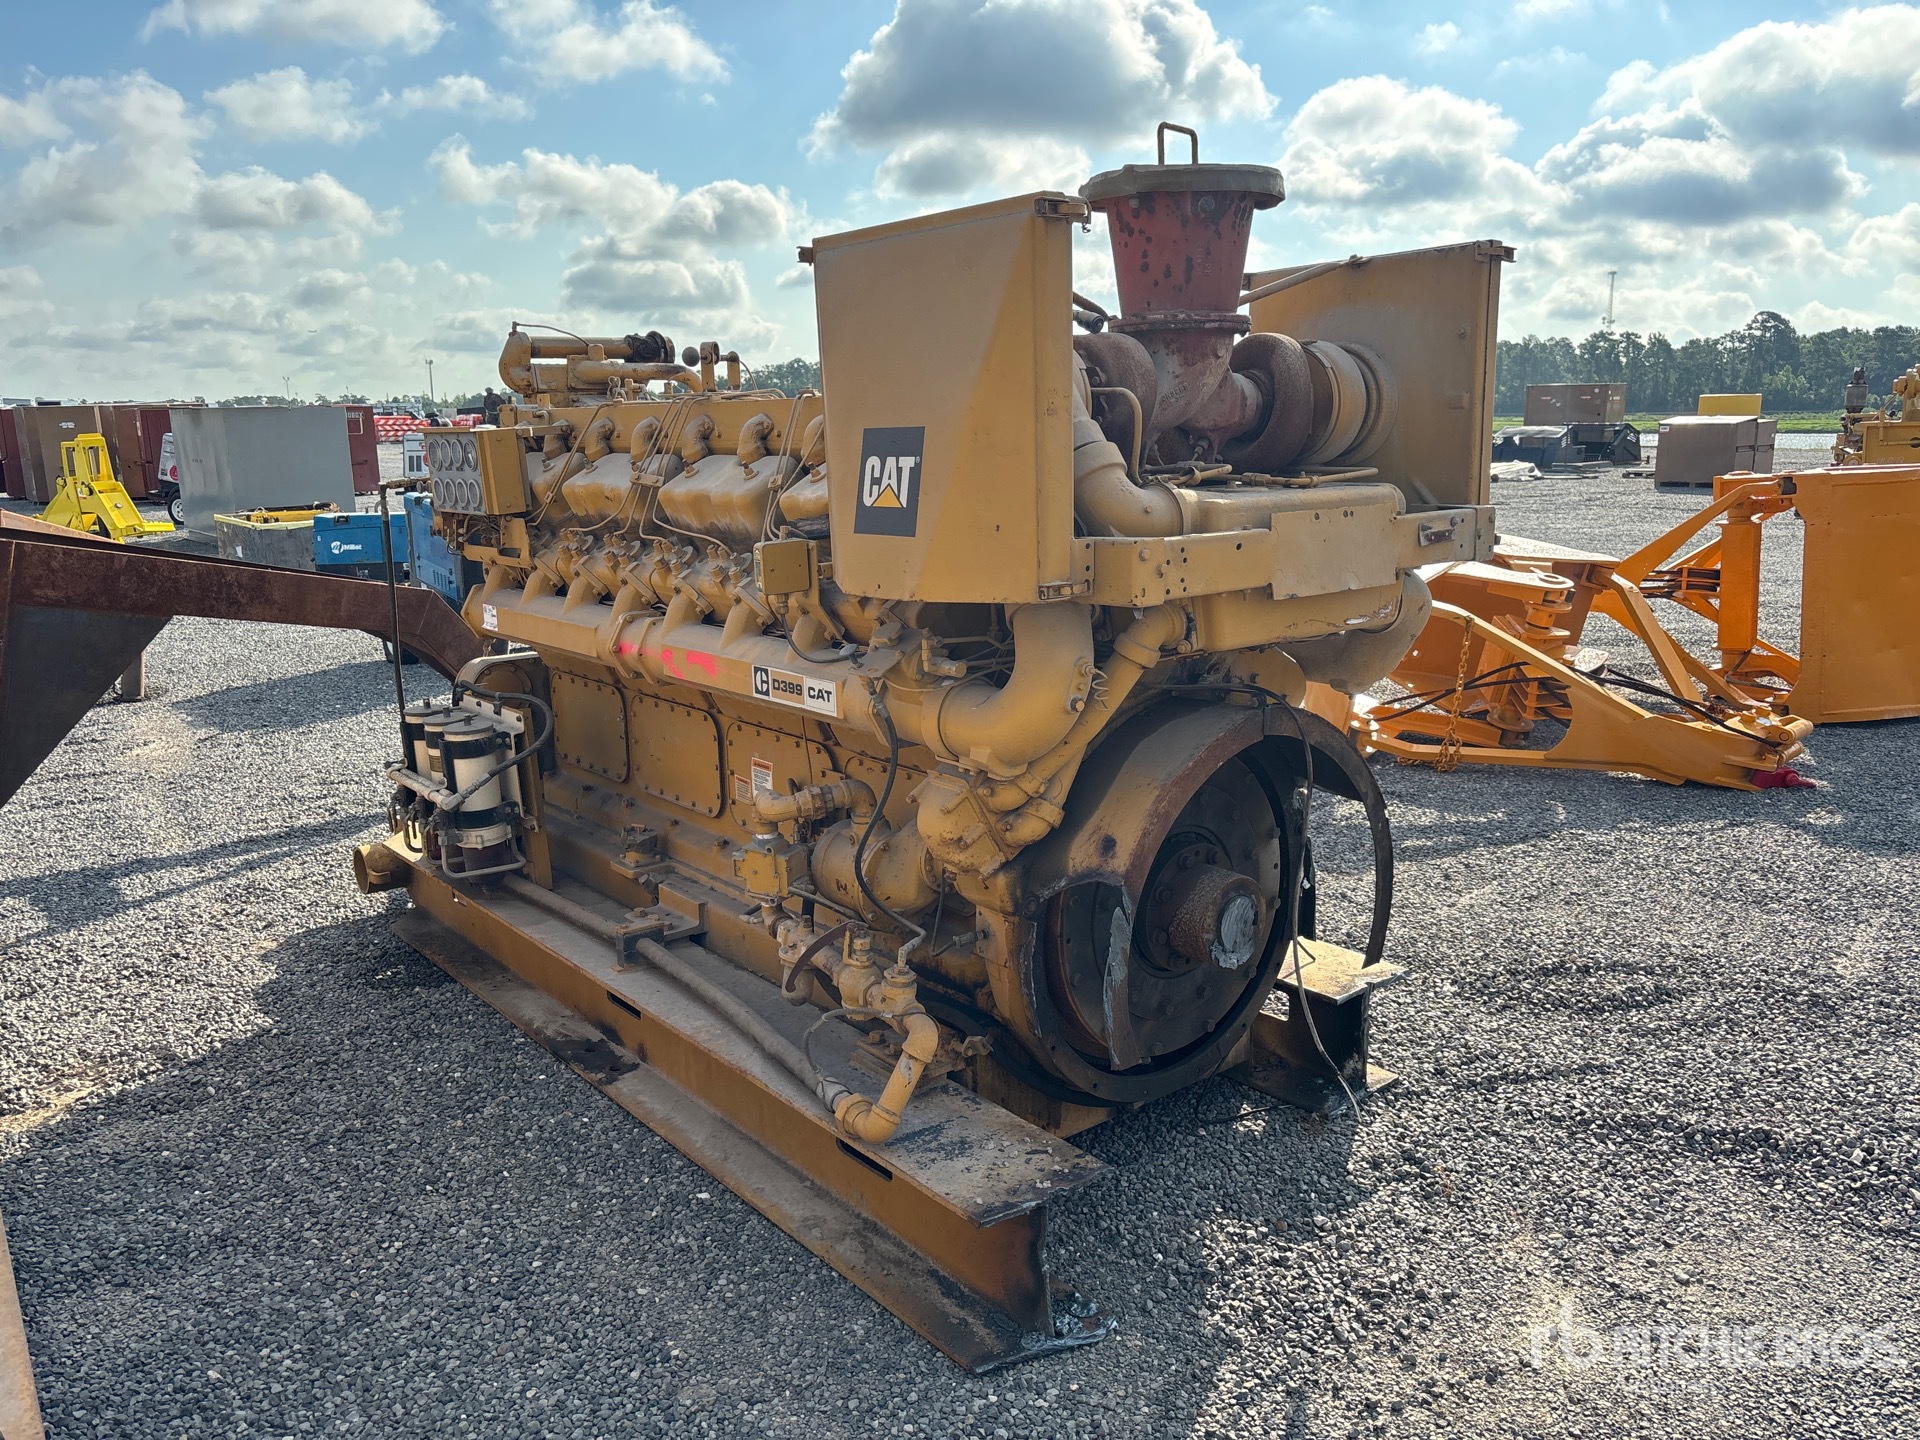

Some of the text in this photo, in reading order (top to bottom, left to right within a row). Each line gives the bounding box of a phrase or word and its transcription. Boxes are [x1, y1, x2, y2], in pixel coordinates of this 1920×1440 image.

[863, 455, 916, 508] CAT
[772, 679, 802, 696] D399
[808, 686, 832, 702] CAT
